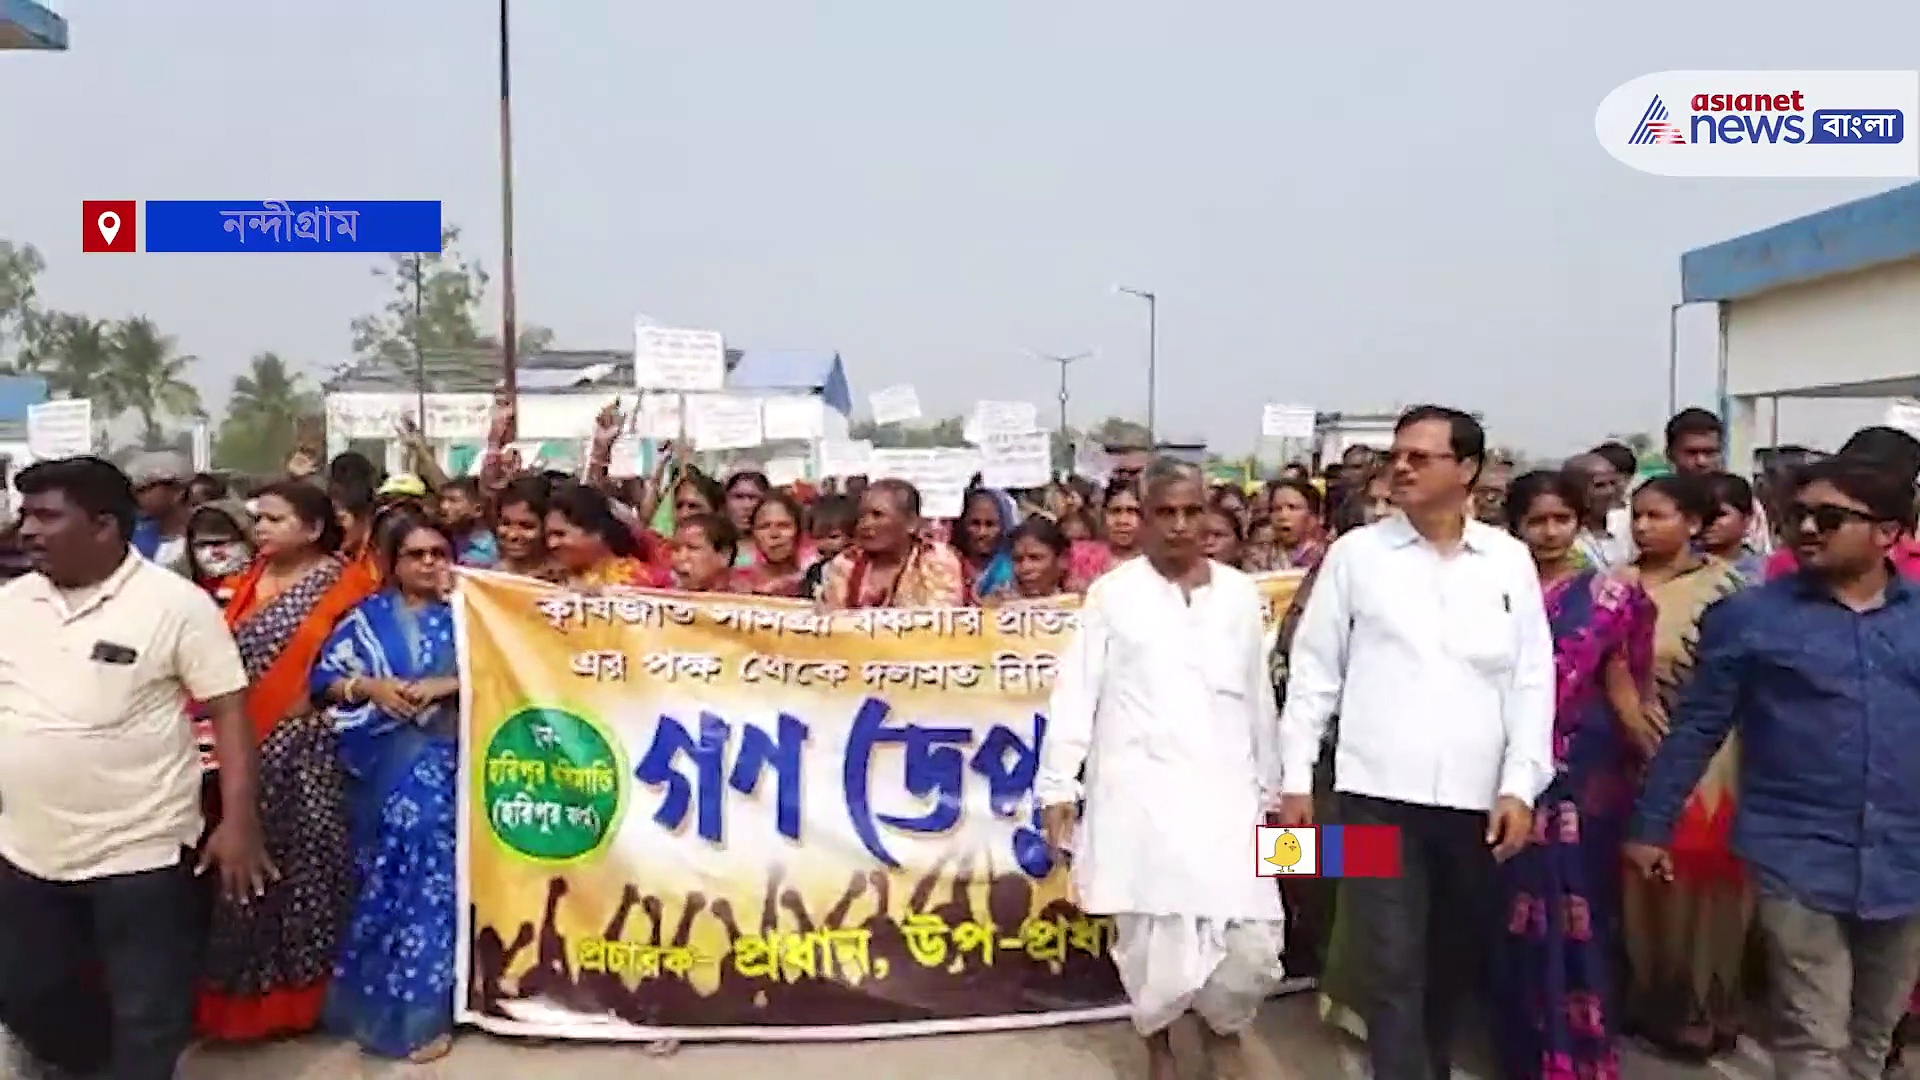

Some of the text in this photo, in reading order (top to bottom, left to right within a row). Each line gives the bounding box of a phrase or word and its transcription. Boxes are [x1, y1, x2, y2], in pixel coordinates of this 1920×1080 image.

[571, 652, 627, 683] এর
[643, 650, 722, 684] পক্ষ
[739, 651, 850, 688] থেকে
[638, 710, 810, 845] গণ
